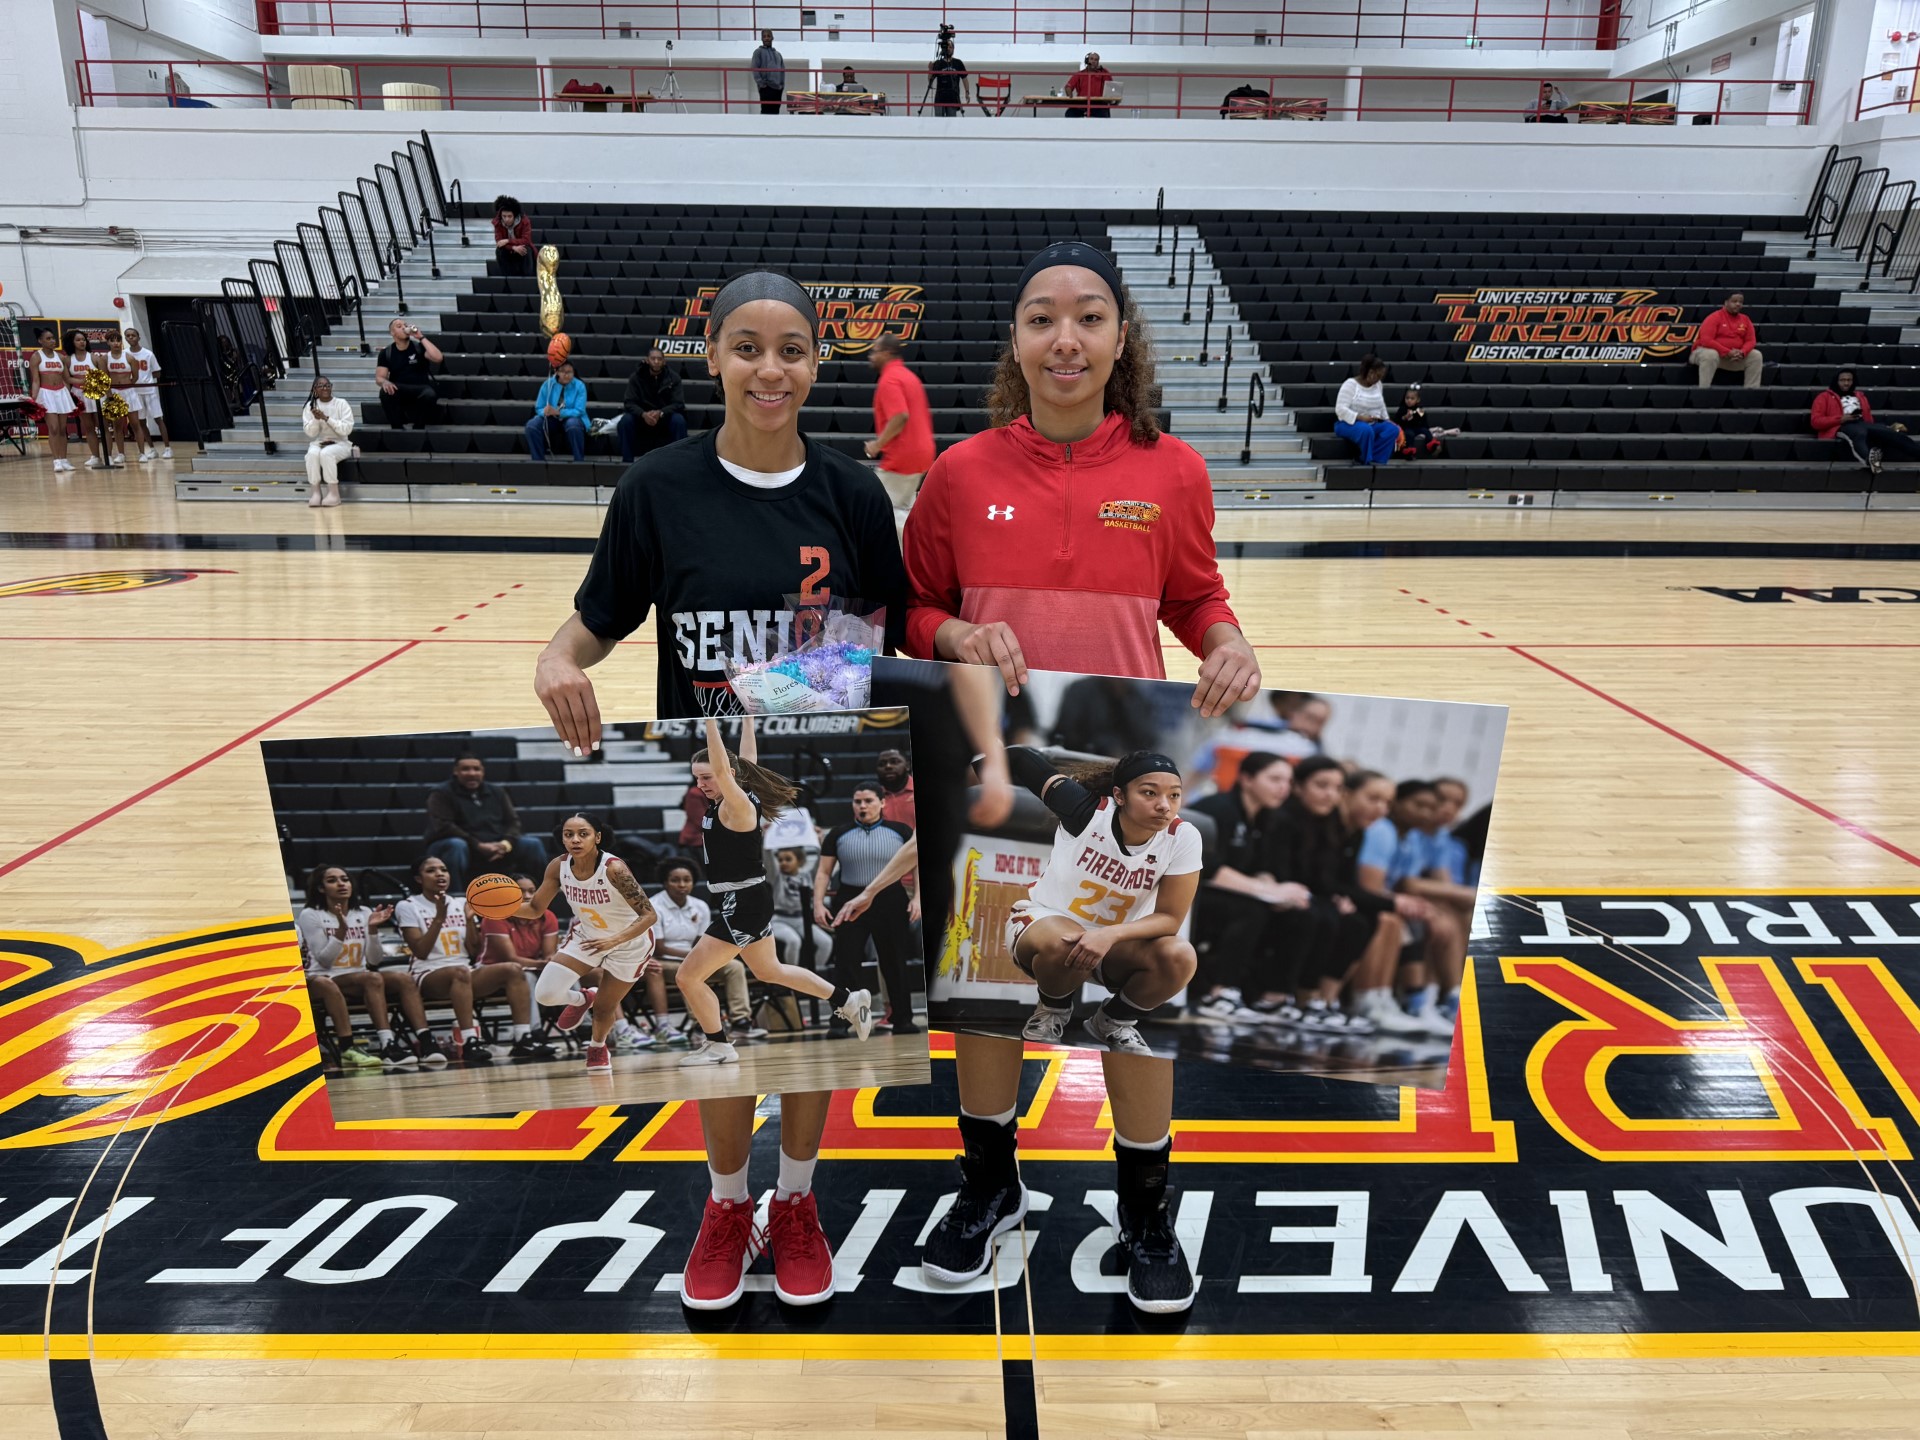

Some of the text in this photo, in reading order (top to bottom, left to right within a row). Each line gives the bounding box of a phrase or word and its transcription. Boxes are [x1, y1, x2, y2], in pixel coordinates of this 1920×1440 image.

[838, 287, 854, 299] OF
[857, 287, 882, 300] THE
[1478, 291, 1616, 304] UNIVERSITY OF THE
[1471, 345, 1642, 360] DISTRICT OF COLUMBIA
[1104, 520, 1151, 532] BASKETBALL
[800, 546, 831, 605] 2
[773, 681, 799, 695] Flores
[763, 715, 859, 735] COLUMBIA
[1076, 846, 1157, 891] FIREBIRDS
[565, 884, 611, 905] FIREBIRDS
[1068, 879, 1137, 926] 23
[580, 907, 609, 929] 3
[334, 942, 362, 967] 20
[145, 1195, 458, 1285] OF
